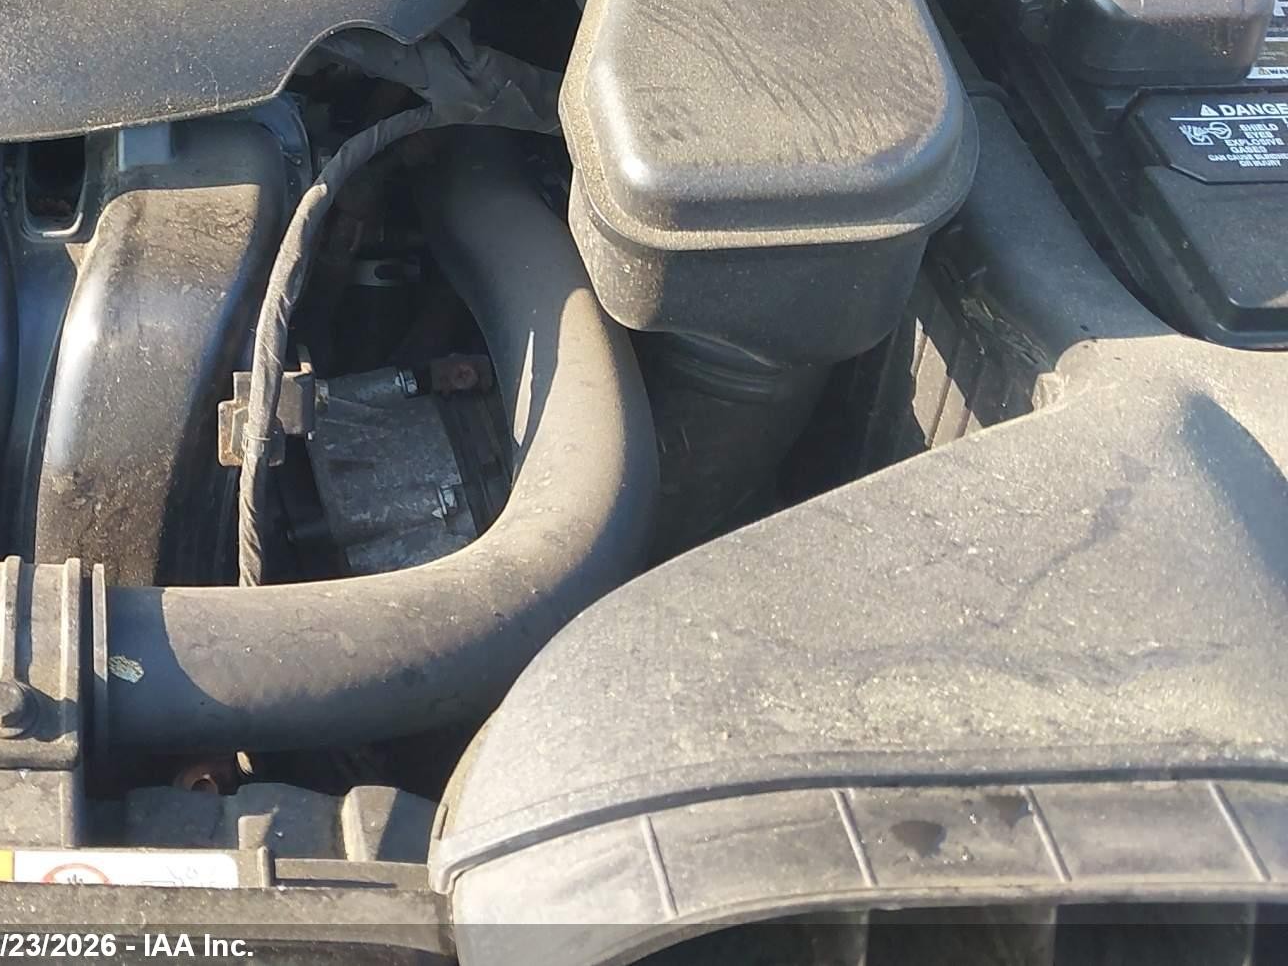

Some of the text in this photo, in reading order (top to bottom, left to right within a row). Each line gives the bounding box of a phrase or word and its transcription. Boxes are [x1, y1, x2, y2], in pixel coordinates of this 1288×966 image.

[1239, 124, 1279, 132] SHIELD
[1244, 131, 1274, 139] EYES
[1224, 138, 1285, 146] EXPLOSIVE
[1230, 146, 1268, 154] GASES
